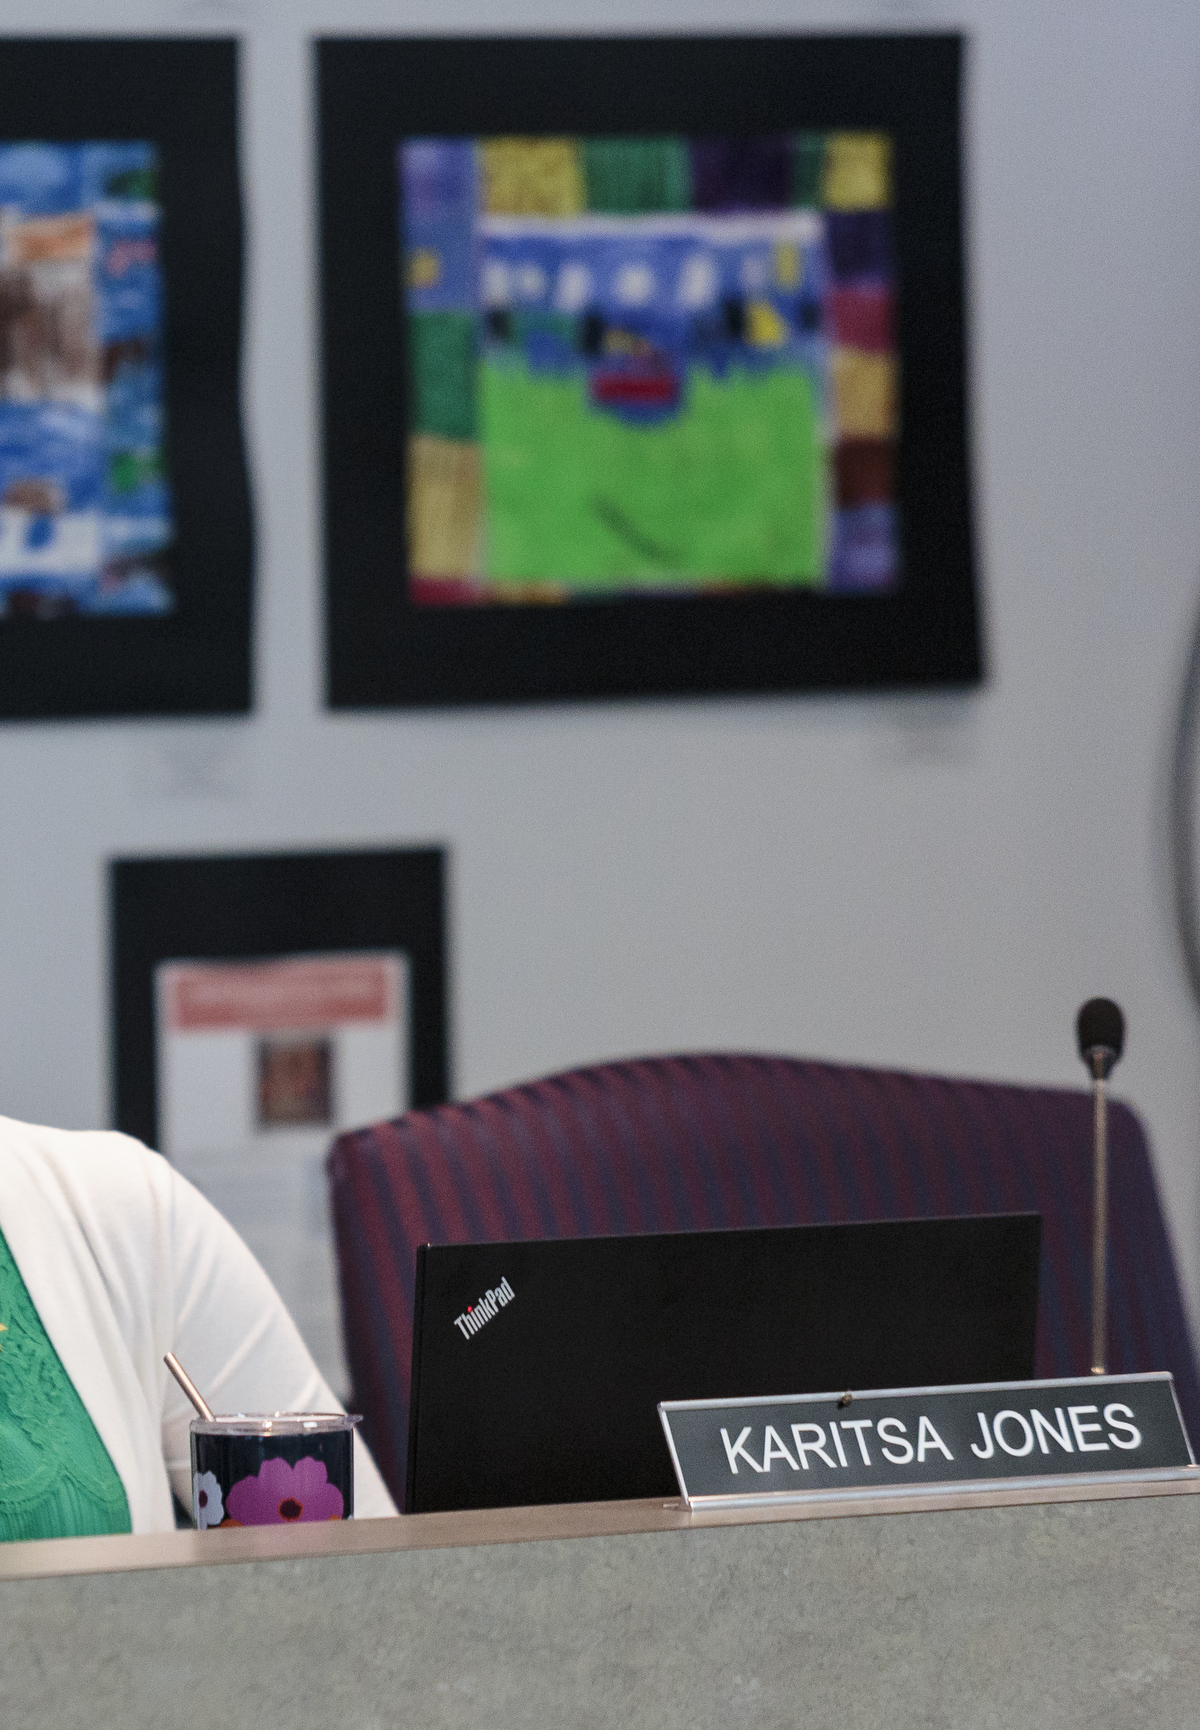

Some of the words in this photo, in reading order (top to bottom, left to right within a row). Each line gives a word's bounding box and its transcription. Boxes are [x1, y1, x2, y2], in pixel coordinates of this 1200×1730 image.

[453, 1276, 516, 1340] ThinkPad
[720, 1415, 954, 1475] KARITSA
[970, 1402, 1142, 1459] JONES
